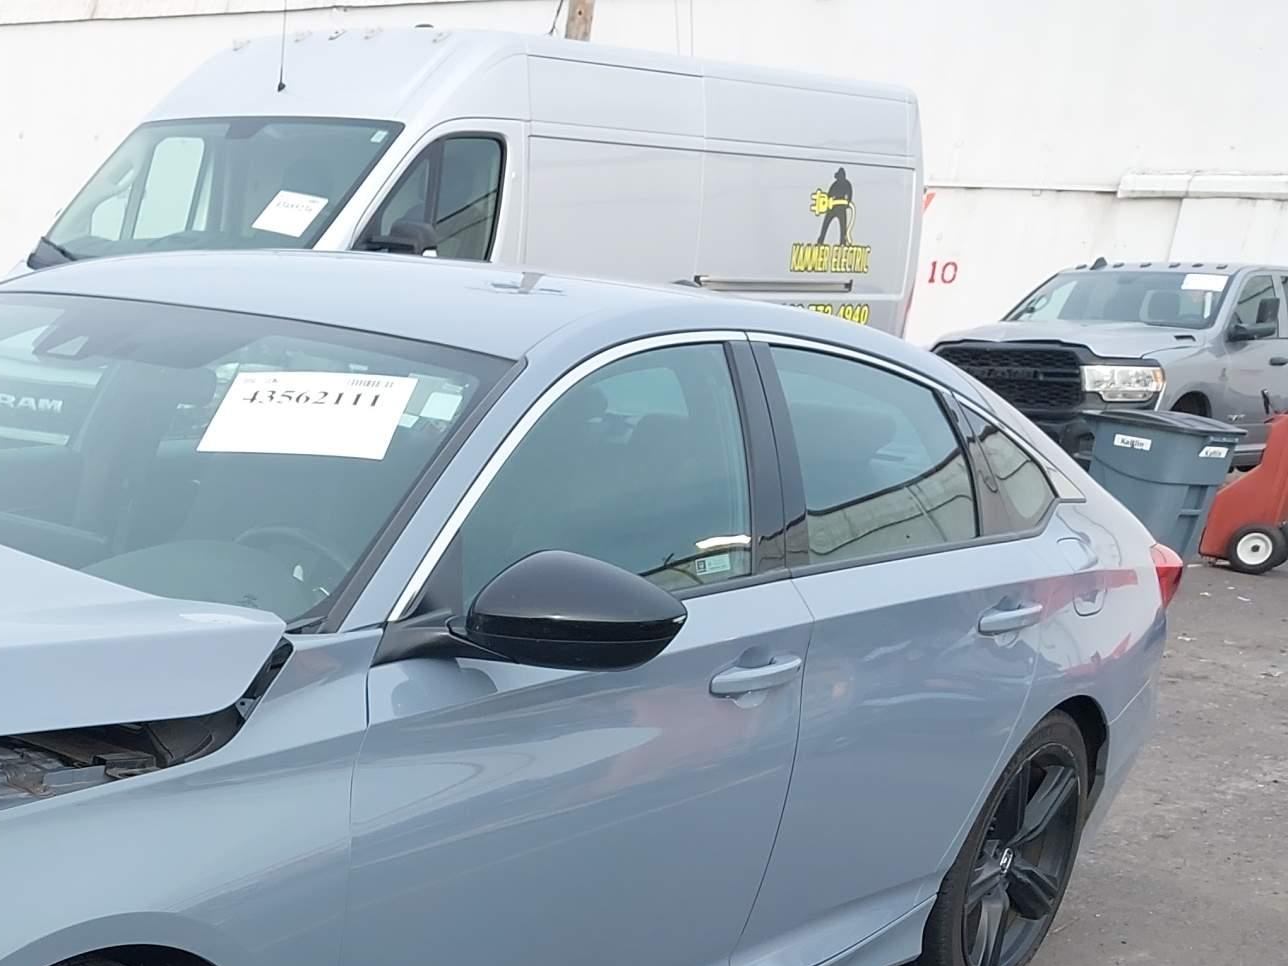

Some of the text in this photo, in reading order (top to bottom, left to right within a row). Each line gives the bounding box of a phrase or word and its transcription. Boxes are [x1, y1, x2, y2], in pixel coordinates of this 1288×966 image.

[830, 244, 871, 273] ELECTRIC
[928, 261, 958, 284] 10
[243, 390, 380, 407] 43562111
